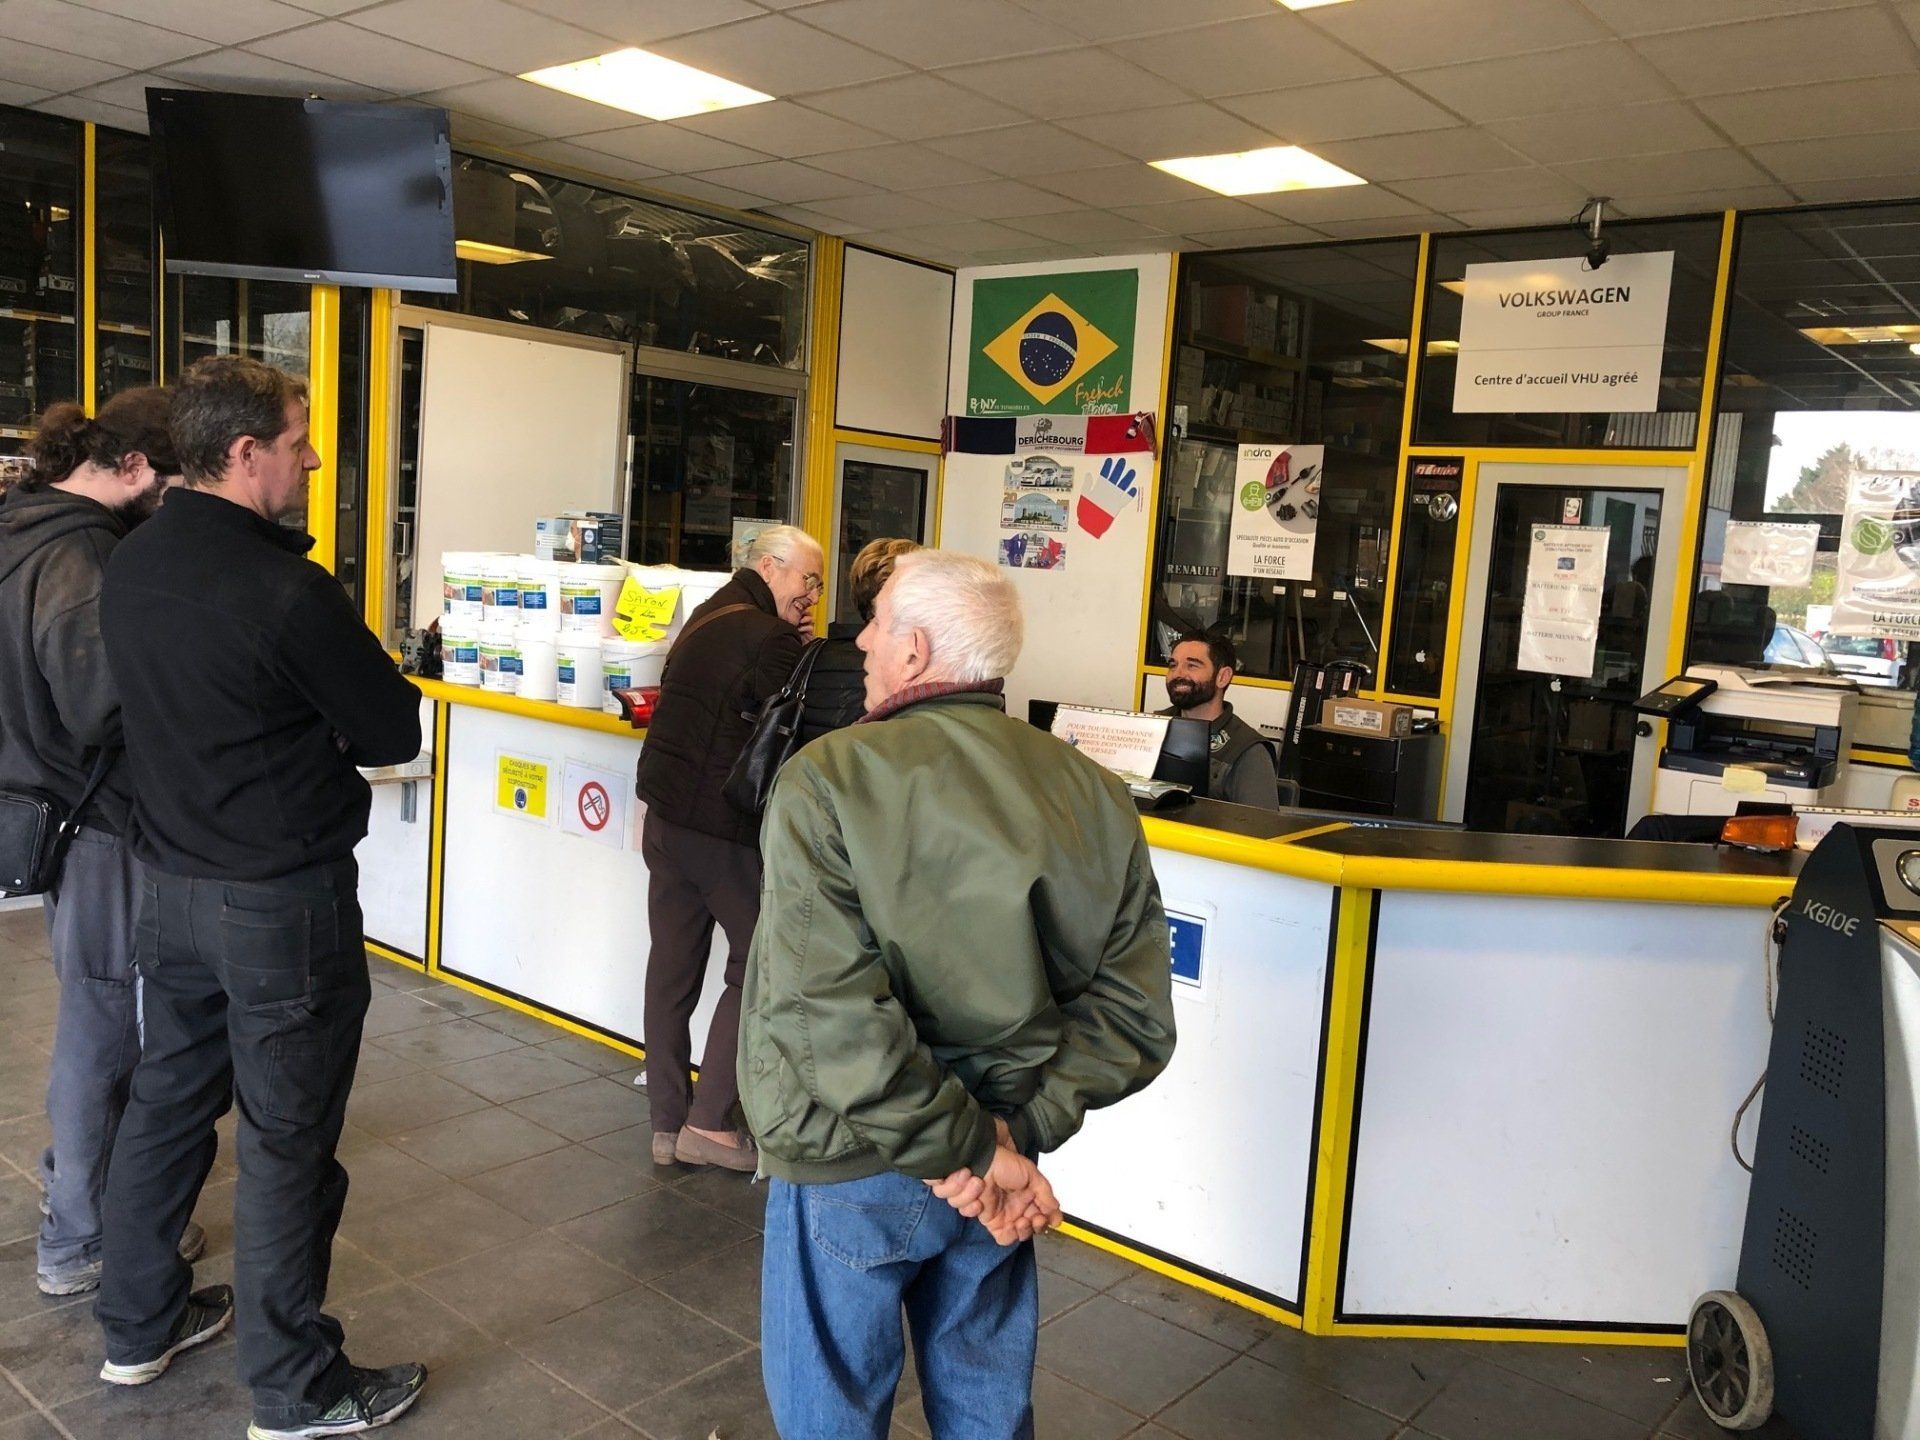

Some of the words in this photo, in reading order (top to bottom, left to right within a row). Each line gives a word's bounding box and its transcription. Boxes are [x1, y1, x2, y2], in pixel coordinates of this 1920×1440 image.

[1499, 286, 1631, 308] VOLKSWAGEN
[1563, 309, 1589, 317] FRANCE
[1474, 374, 1513, 386] Centre
[1515, 373, 1567, 385] d'accueil
[1571, 373, 1599, 384] VHU
[1602, 372, 1638, 387] agréé
[1075, 375, 1124, 406] French
[1018, 435, 1084, 446] DERICHEBOURG
[1244, 447, 1272, 458] indra
[1254, 555, 1262, 565] LA
[1264, 556, 1286, 566] FORCE
[1167, 564, 1219, 578] RENAULT
[1872, 611, 1886, 623] LA
[1066, 723, 1087, 731] POUR
[1087, 725, 1111, 734] TOUTE
[1111, 728, 1154, 739] COMMANDE
[1803, 899, 1860, 937] K610E
